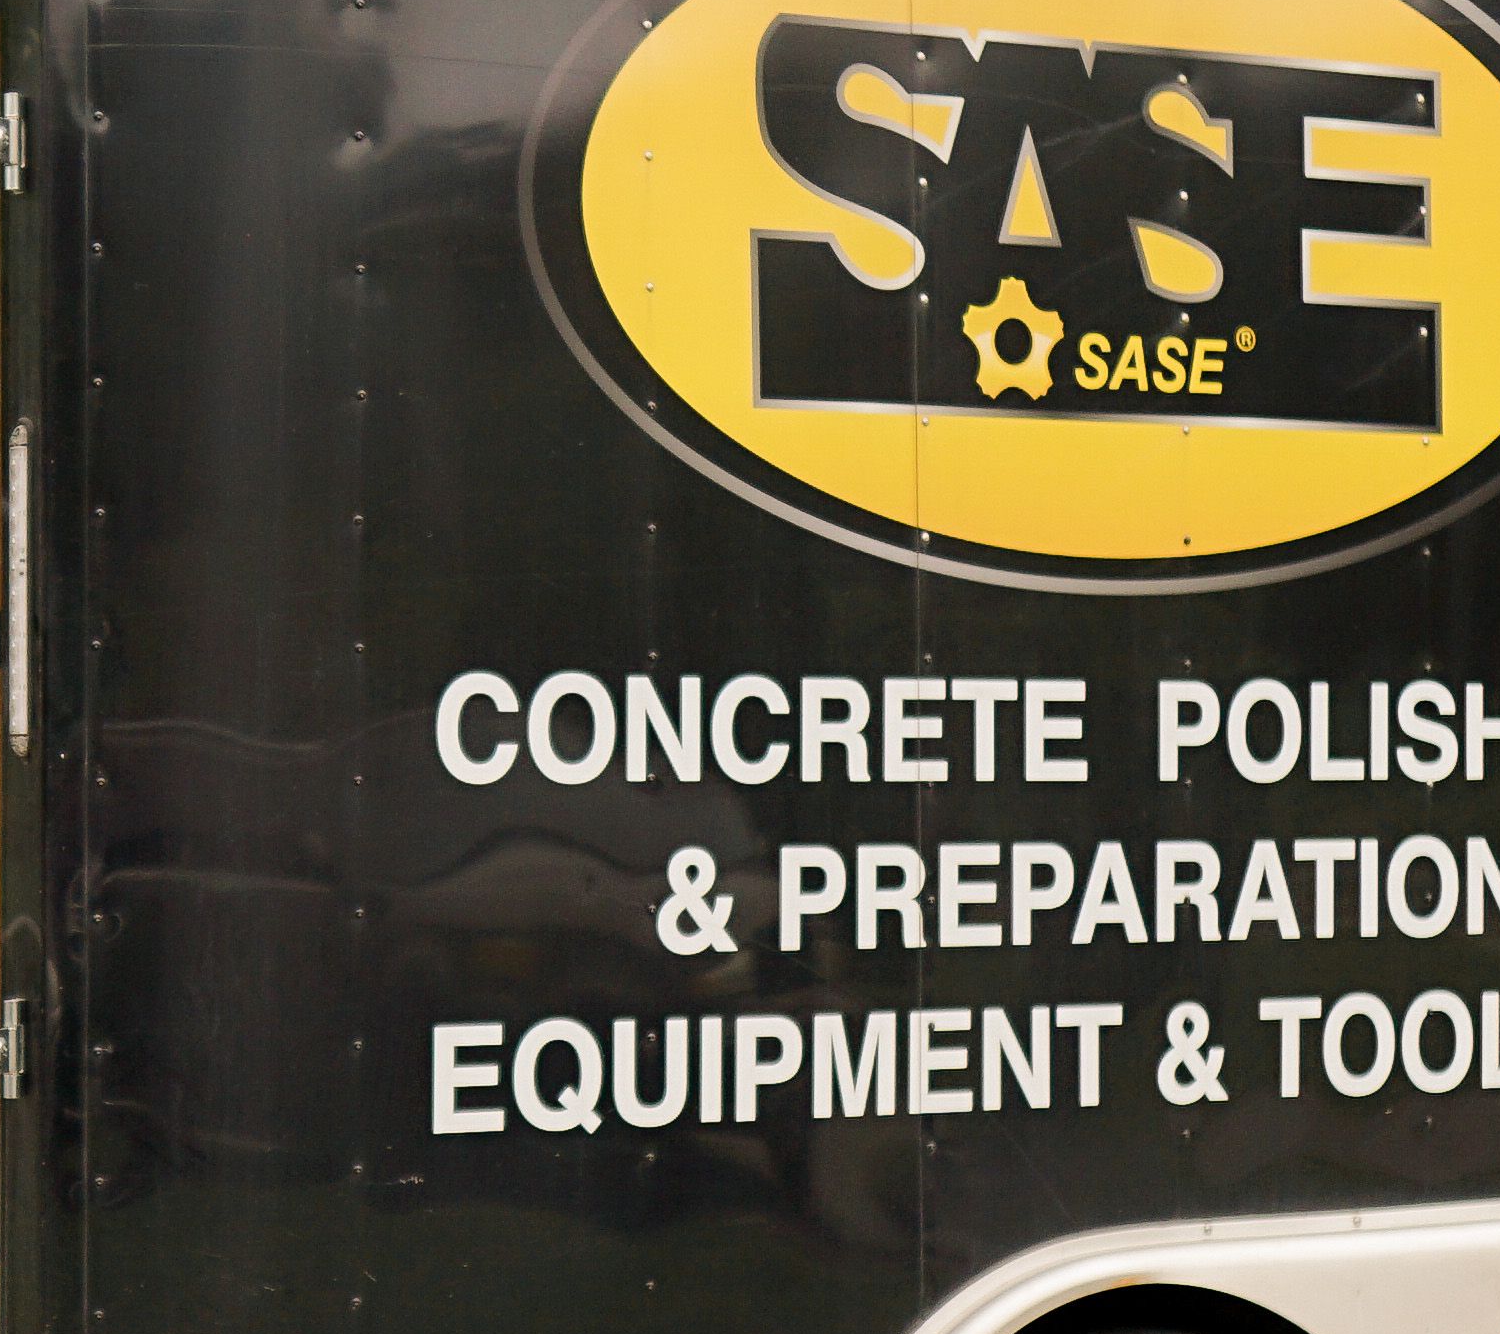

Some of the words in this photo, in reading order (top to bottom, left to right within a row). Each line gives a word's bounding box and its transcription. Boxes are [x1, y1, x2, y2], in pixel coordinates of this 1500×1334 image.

[750, 12, 1443, 434] SASE
[435, 671, 1089, 786] CONCRETE
[655, 845, 739, 956] &
[432, 1002, 1124, 1135] EQUIPMENT
[1157, 1001, 1229, 1106] &
